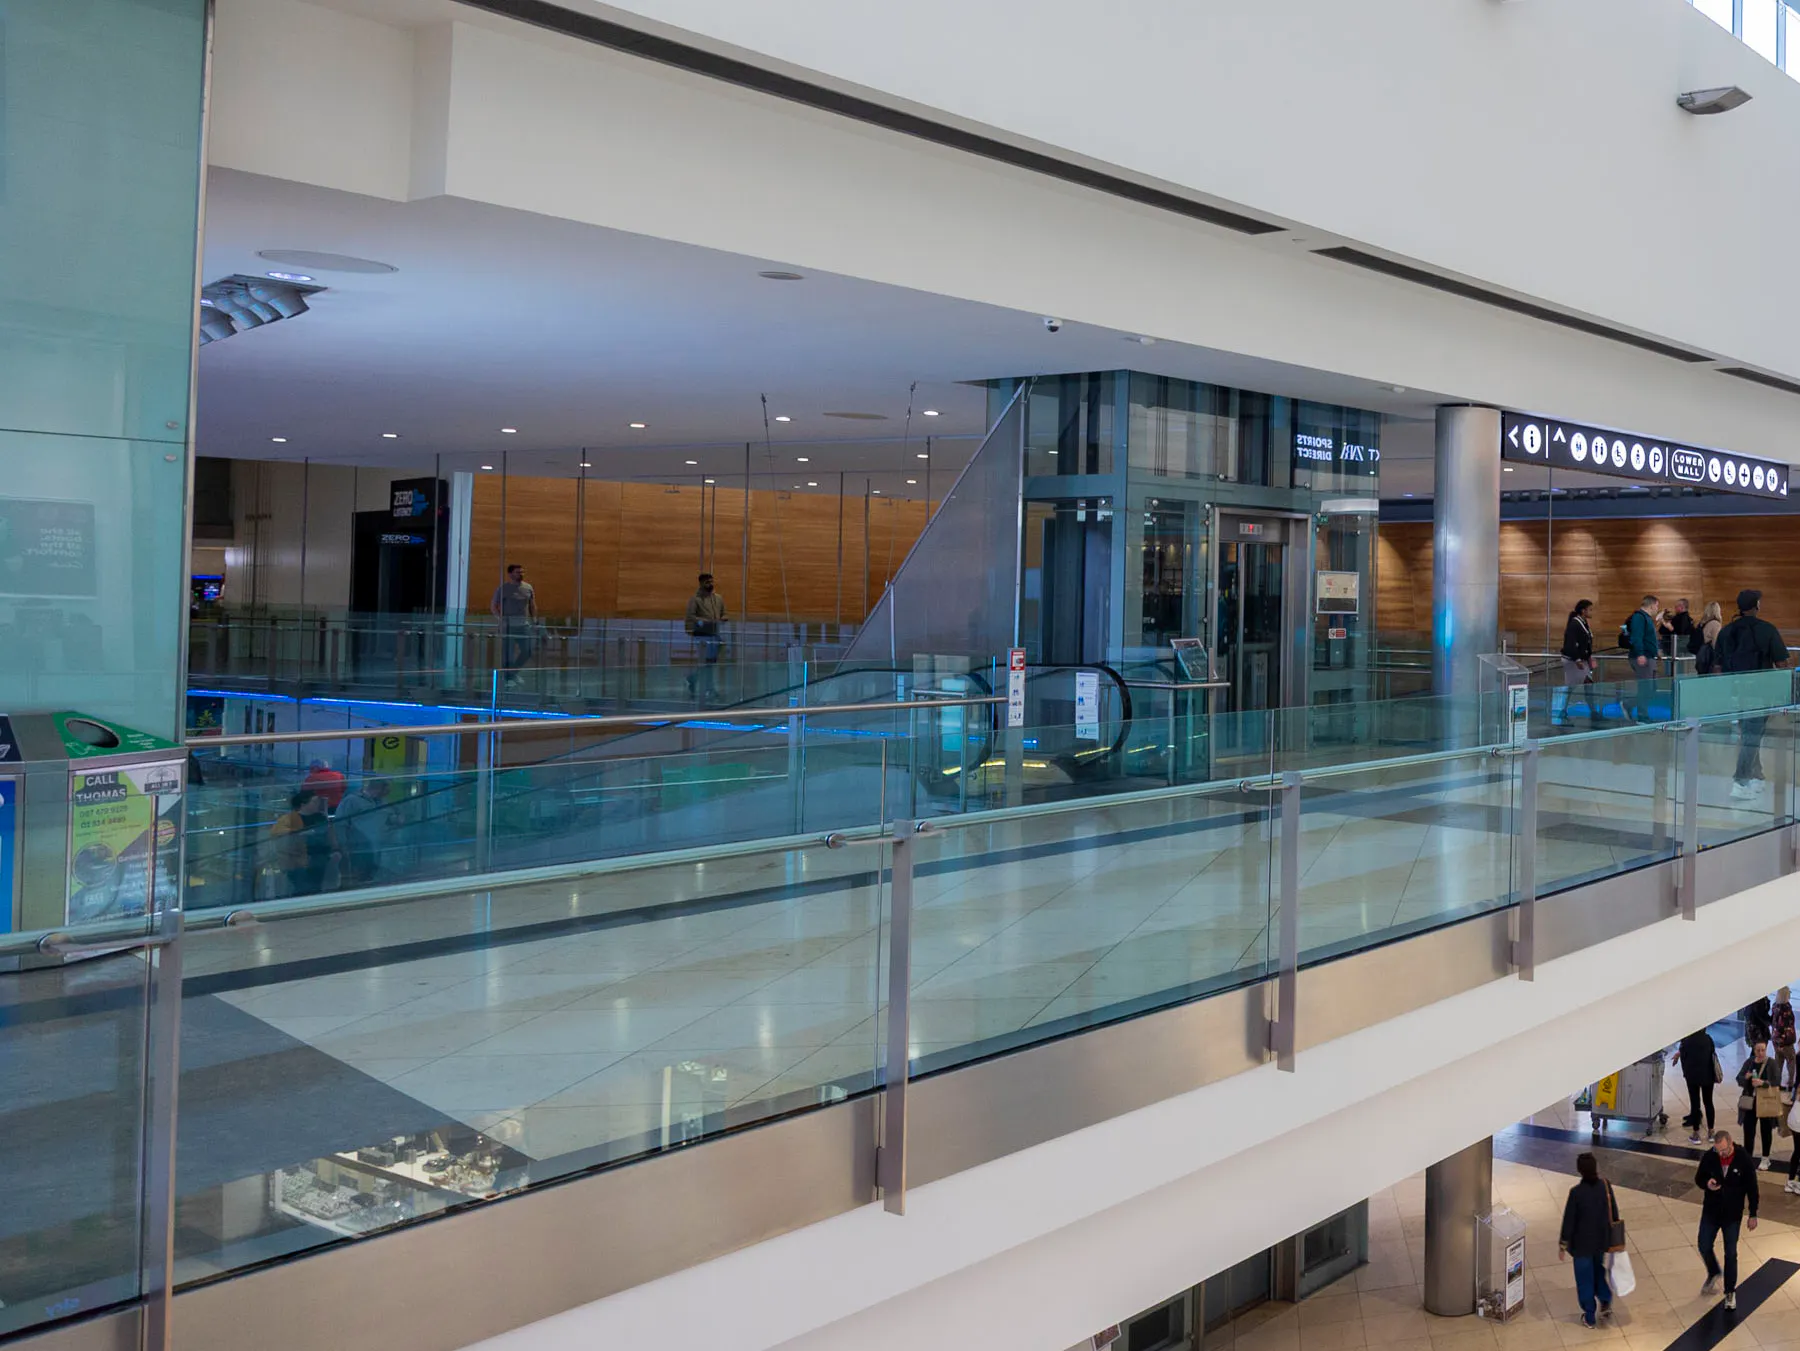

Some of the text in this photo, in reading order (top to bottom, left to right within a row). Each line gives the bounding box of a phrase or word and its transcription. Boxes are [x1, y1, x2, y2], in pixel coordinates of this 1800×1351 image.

[1674, 454, 1703, 468] LOWER
[1677, 465, 1700, 477] MALL
[394, 490, 413, 506] ZERO
[86, 775, 116, 787] CALL
[76, 788, 126, 802] THOMAS
